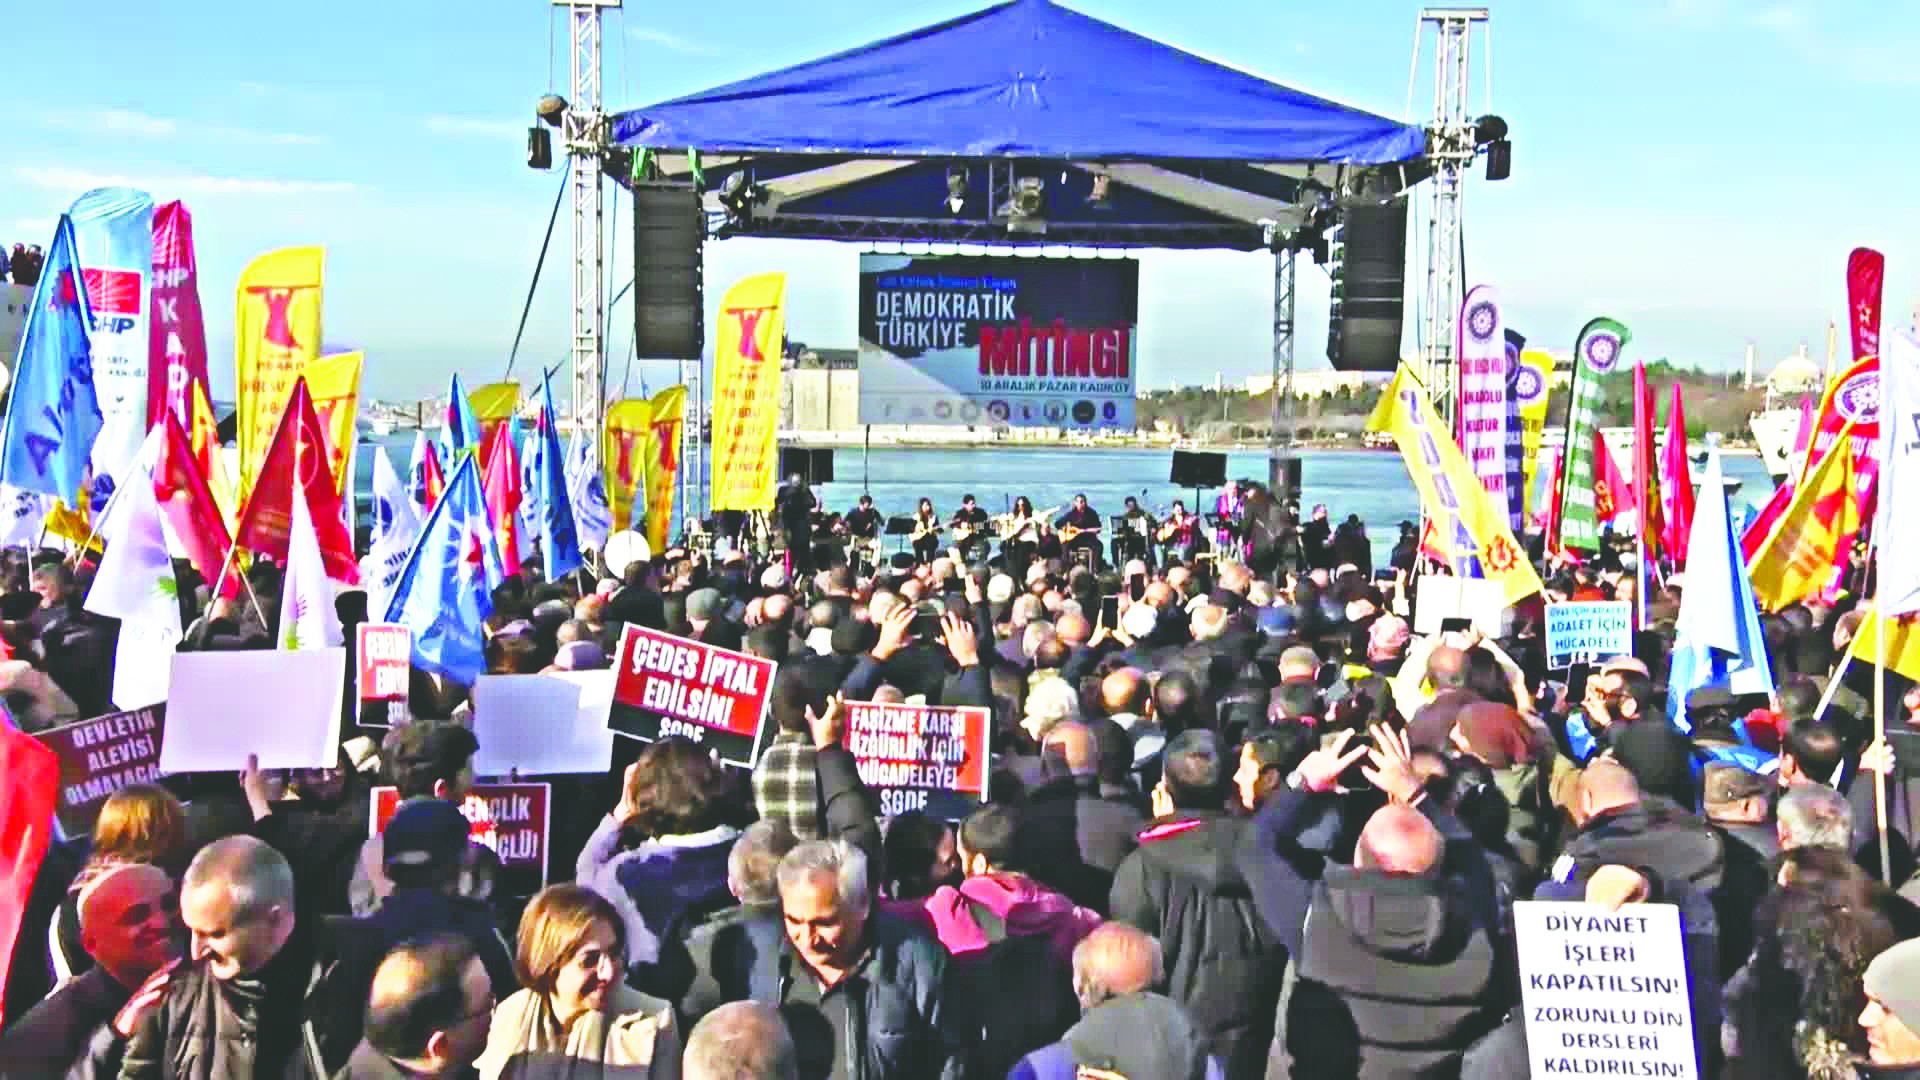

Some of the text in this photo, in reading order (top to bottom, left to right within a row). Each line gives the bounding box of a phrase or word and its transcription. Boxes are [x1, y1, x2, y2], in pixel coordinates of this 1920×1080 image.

[876, 289, 1016, 321] DEMOKRATİK
[875, 317, 967, 348] TÜRKİYE
[994, 380, 1036, 392] ARALIK
[1039, 381, 1077, 393] PAZAR
[1551, 616, 1626, 634] ADALET İÇİN
[1555, 636, 1620, 650] MÜCADELE
[632, 635, 759, 697] ÇEDES İPTAL
[642, 676, 736, 728] EDİLSİN!
[851, 706, 966, 740] FAŞİZME KARŞI
[87, 733, 155, 772] ALEVİSİ
[65, 762, 167, 805] OLMAYACA
[457, 792, 531, 828] ENÇLİK
[1546, 911, 1648, 933] DİYANET
[1564, 939, 1636, 966] İŞLERİ
[1530, 973, 1679, 994] KAPATILSIN!
[1534, 1007, 1683, 1027] ZORUNLU DİN
[1562, 1031, 1659, 1051] DERSLERİ
[1544, 1057, 1685, 1078] KALDIRILSIN!
